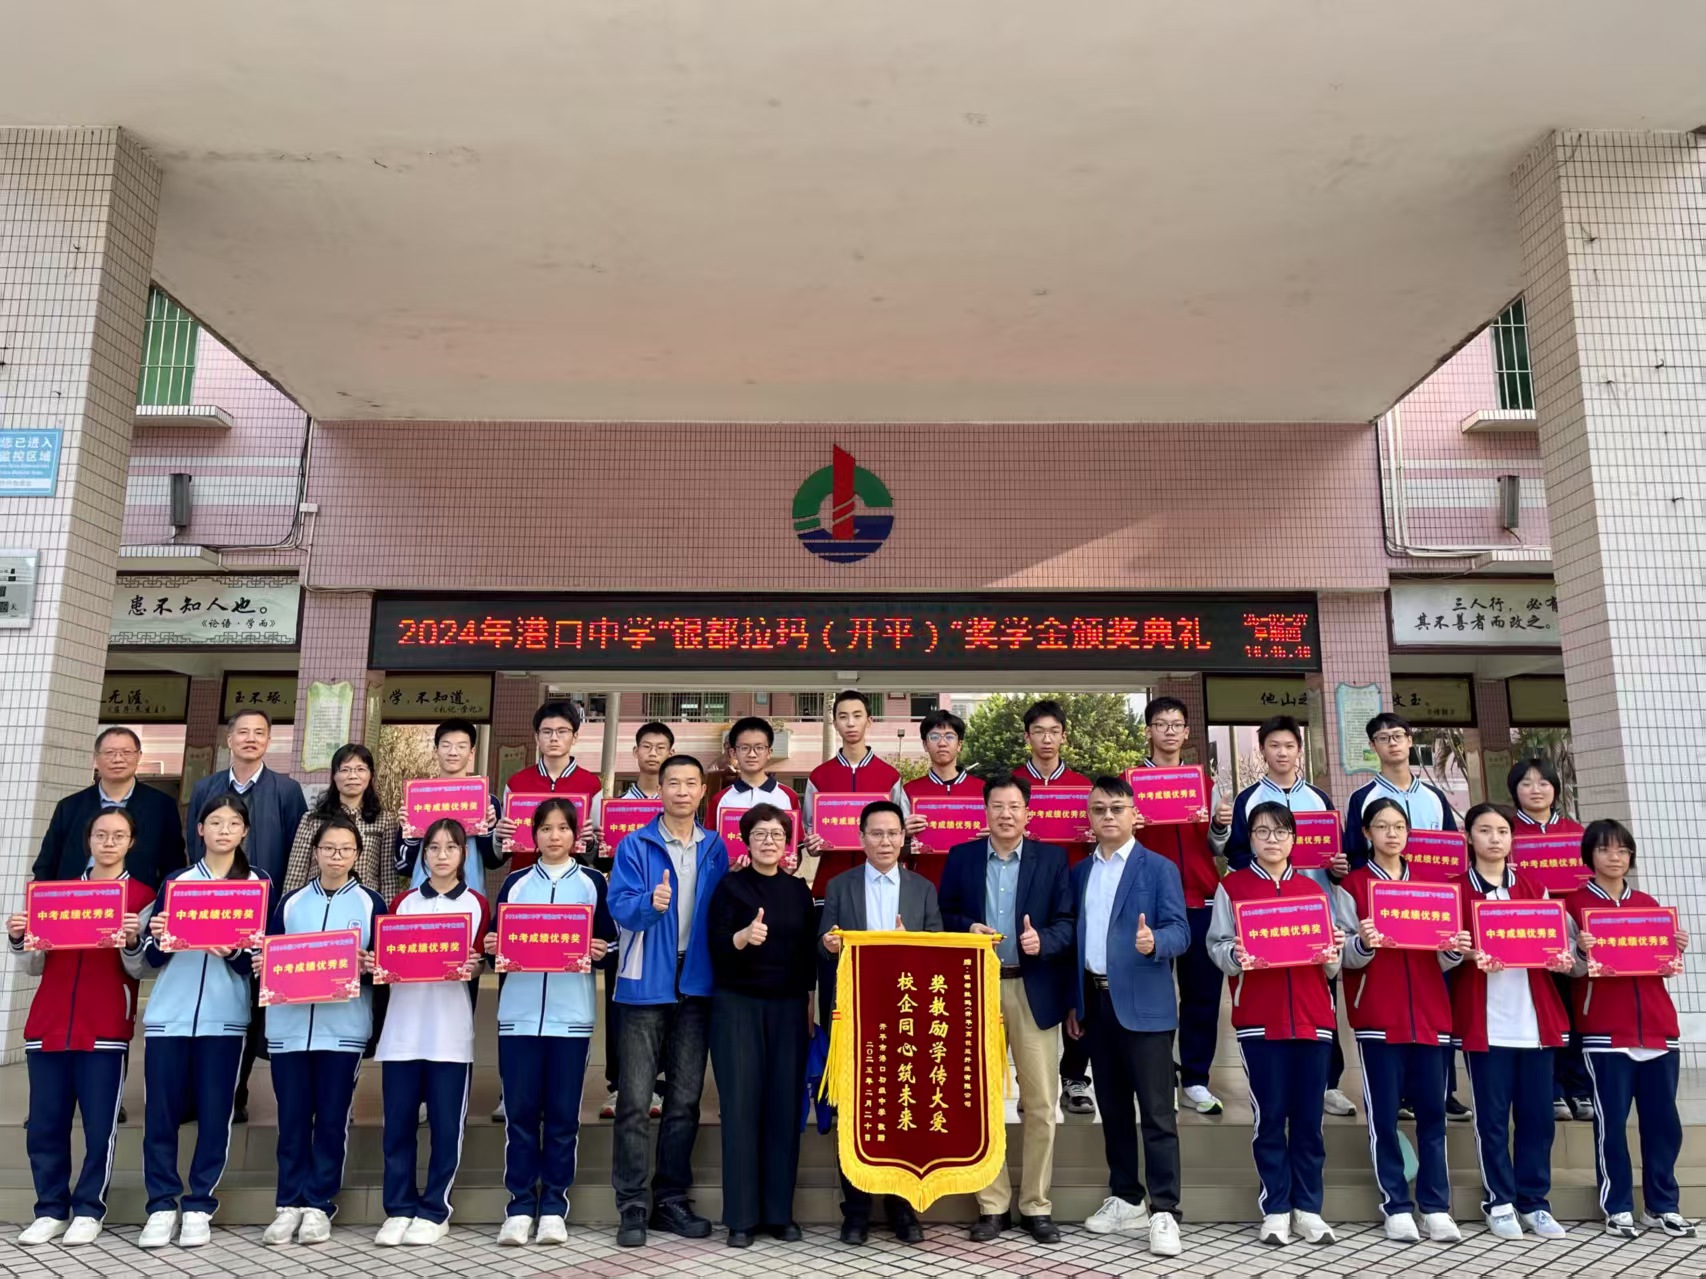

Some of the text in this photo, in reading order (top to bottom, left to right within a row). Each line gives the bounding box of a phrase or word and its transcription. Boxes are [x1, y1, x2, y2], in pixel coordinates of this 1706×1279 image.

[128, 594, 268, 615] 患不知人也。
[1414, 612, 1551, 631] 其不善者而改之。
[100, 689, 150, 704] 无涯。
[382, 689, 470, 704] 学，不知道。
[1137, 789, 1197, 800] 中考成绩优秀奖
[413, 801, 478, 813] 中考成绩优秀奖
[821, 816, 860, 825] 中考成绩
[929, 820, 981, 830] 考成绩优秀奖
[1296, 835, 1331, 845] 绩优秀奖
[1404, 853, 1459, 866] 考成绩优秀奖
[38, 908, 114, 920] 中考成绩优秀奖
[175, 909, 254, 920] 中考成绩优秀奖
[1380, 908, 1451, 922] 中考成绩优秀奖
[1249, 923, 1321, 939] 中考成绩优秀奖
[1486, 927, 1556, 940] 中考成绩优秀奖
[508, 932, 581, 944] 中考成绩优秀奖
[1596, 935, 1668, 948] 中考成绩优秀奖
[386, 942, 460, 955] 中考成绩优秀奖
[273, 958, 348, 975] 中考成绩优秀奖
[896, 971, 919, 1132] 校企同心筑未来
[928, 974, 949, 1134] 奖教励学传大爱
